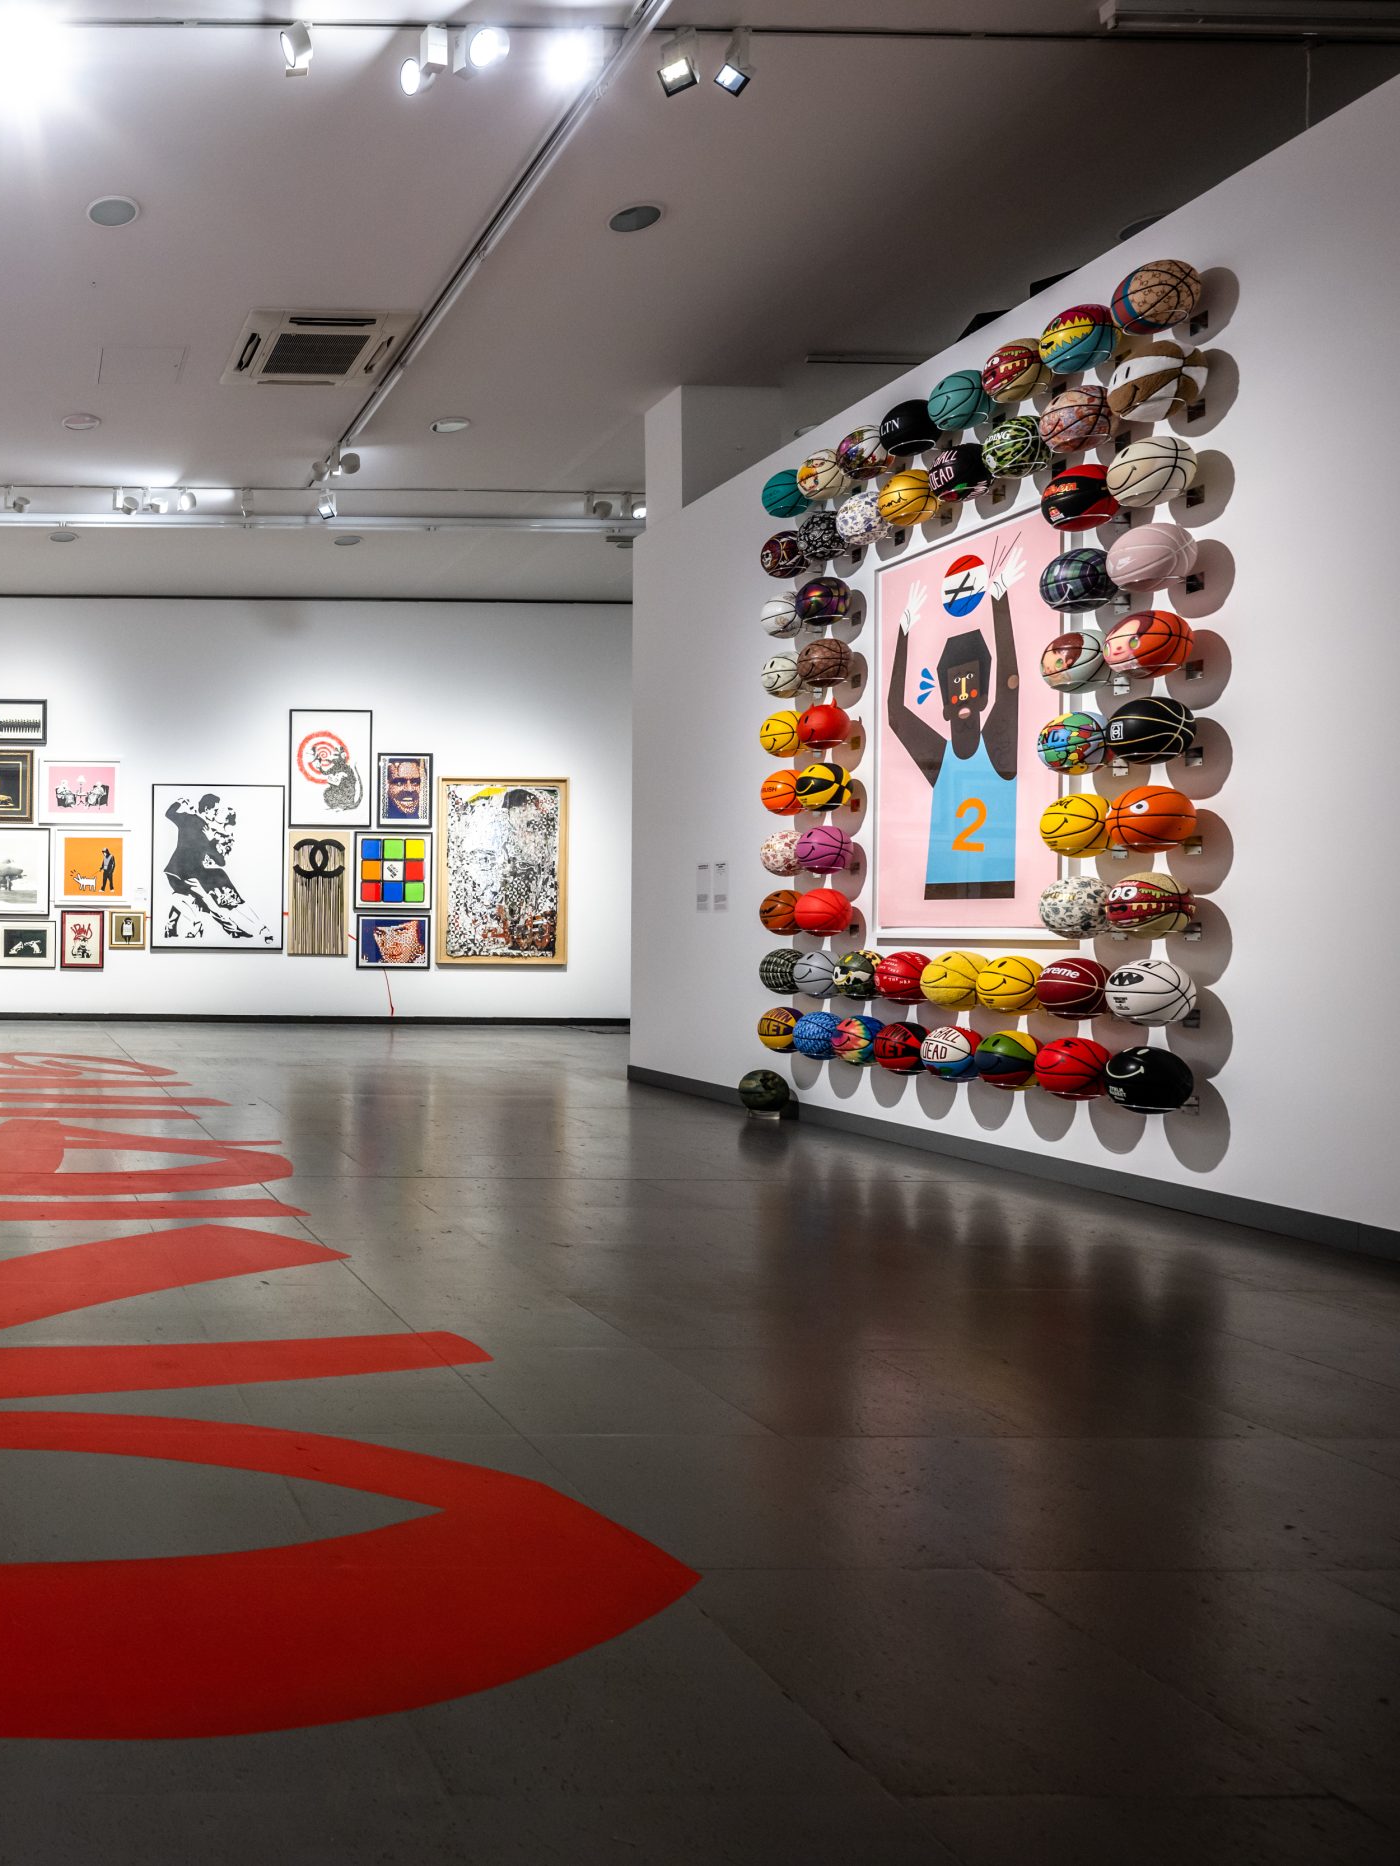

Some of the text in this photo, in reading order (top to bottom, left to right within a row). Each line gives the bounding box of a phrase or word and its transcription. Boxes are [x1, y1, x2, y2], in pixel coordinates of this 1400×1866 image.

[929, 466, 955, 491] DEAD
[953, 798, 987, 852] 2
[922, 1041, 948, 1060] DEAD
